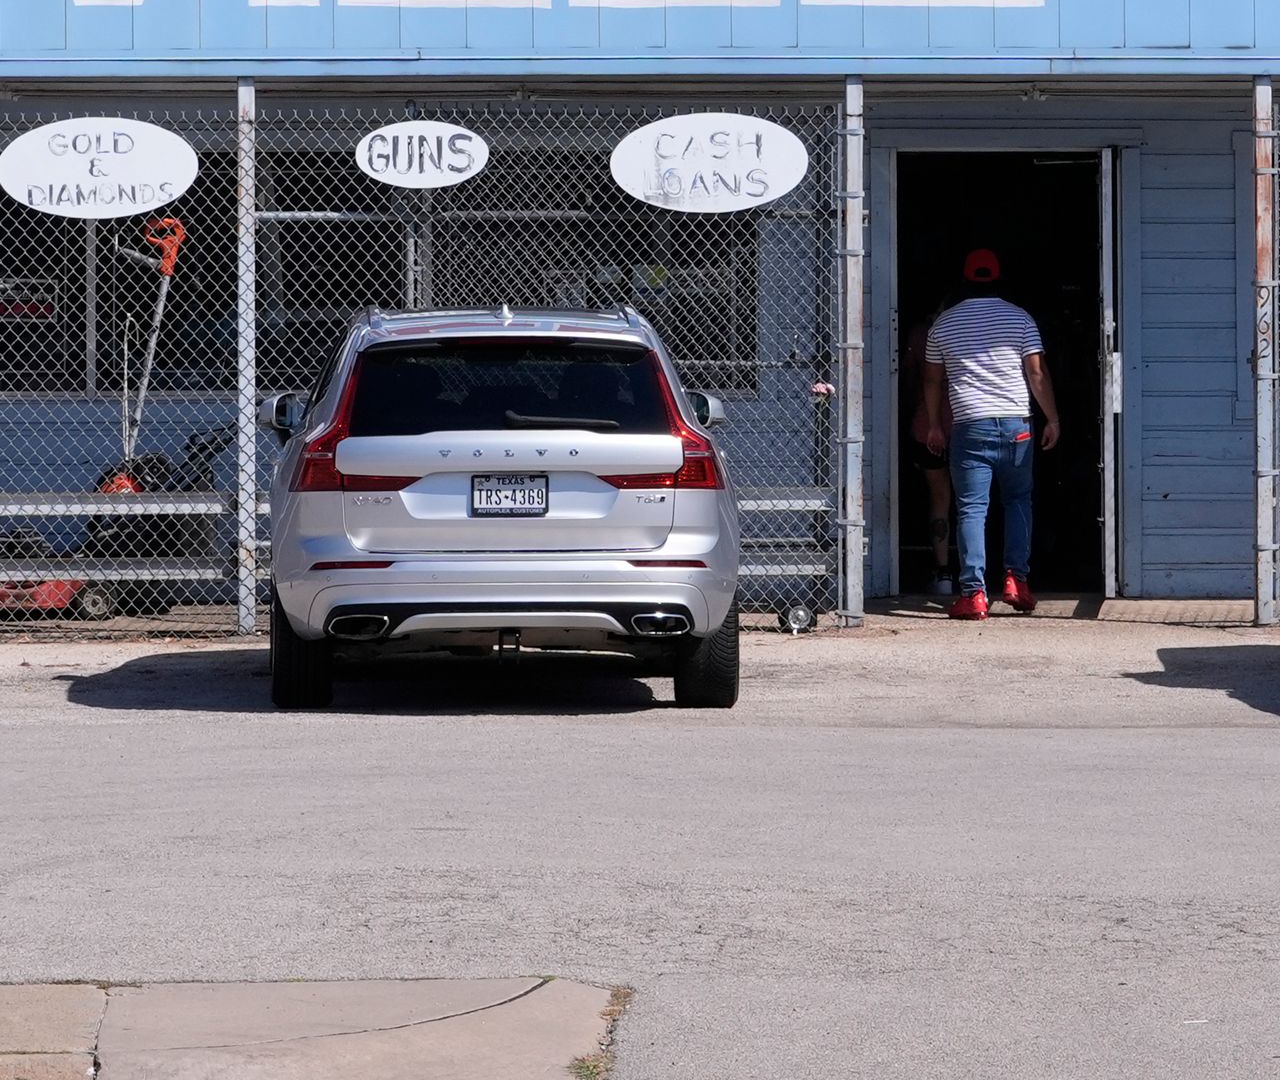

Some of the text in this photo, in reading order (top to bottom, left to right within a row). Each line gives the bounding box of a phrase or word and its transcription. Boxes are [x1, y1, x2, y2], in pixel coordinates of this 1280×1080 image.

[47, 132, 135, 157] GOLD
[367, 133, 475, 174] GUNS
[655, 131, 763, 160] CASH
[88, 157, 110, 178] &
[27, 182, 174, 208] DIAMONDS
[643, 168, 769, 200] LOANS
[438, 448, 579, 458] VOLVO
[496, 476, 525, 486] TEXAS
